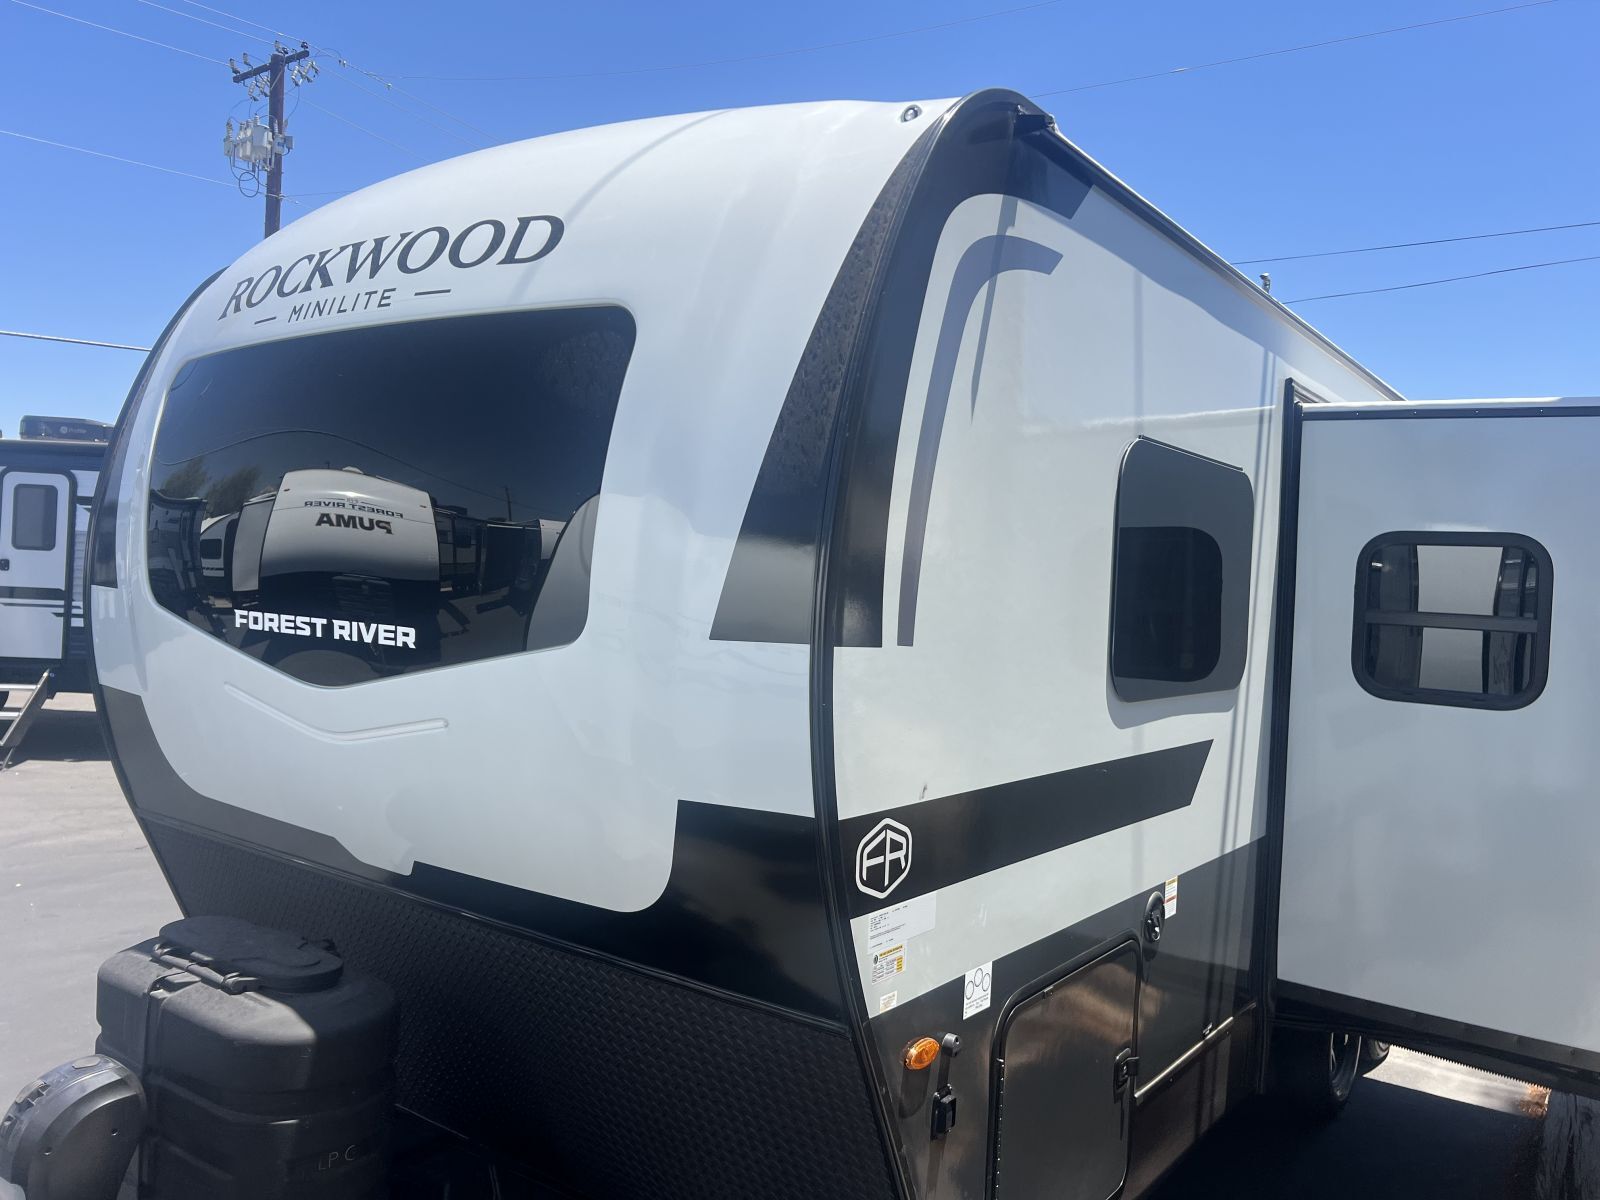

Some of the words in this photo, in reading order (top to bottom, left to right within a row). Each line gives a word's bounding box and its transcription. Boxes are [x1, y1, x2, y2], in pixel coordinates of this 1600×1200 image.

[217, 214, 565, 321] ROCKWOOD
[287, 287, 397, 323] MINILITE
[234, 608, 328, 638] FOREST
[332, 619, 416, 649] RIVER
